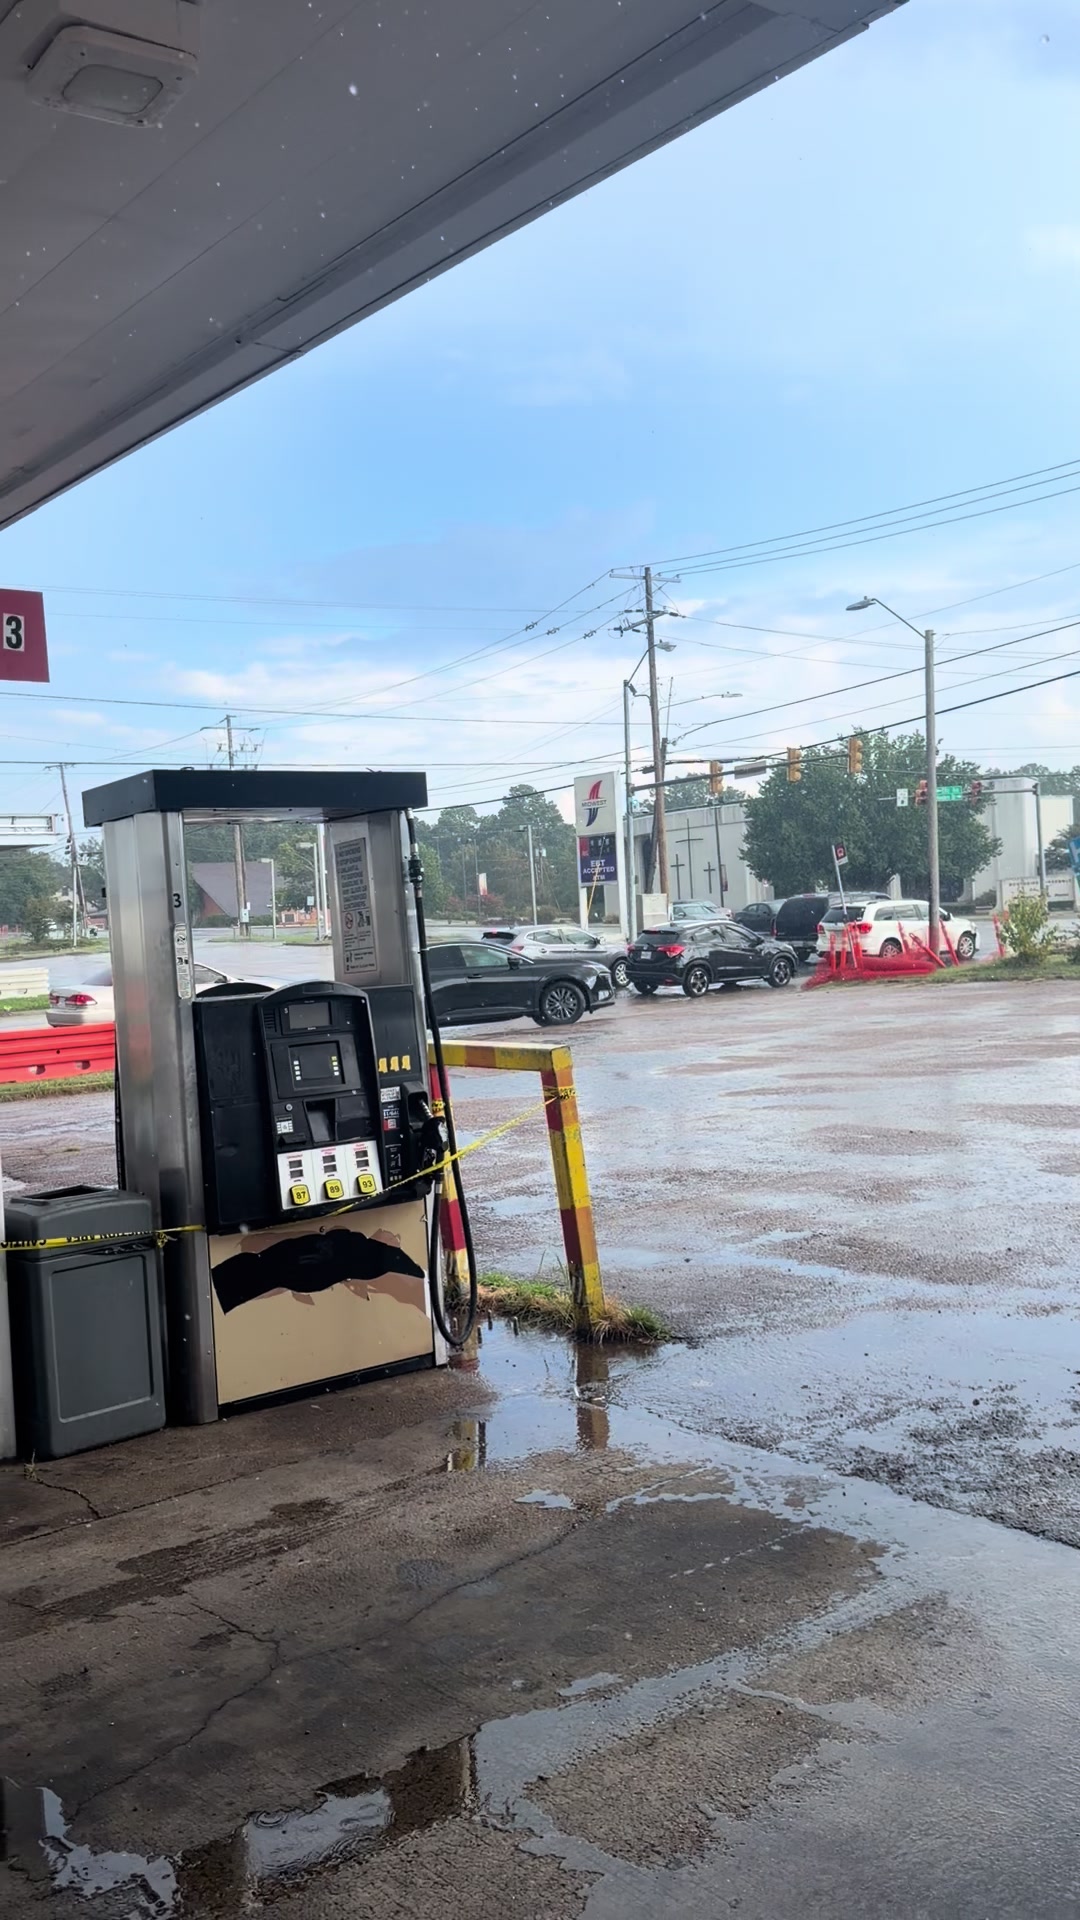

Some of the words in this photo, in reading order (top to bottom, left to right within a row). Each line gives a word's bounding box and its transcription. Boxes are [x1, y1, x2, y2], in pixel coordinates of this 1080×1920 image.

[6, 615, 22, 649] 3
[581, 799, 607, 808] MIDWEST
[172, 892, 182, 908] 3
[362, 1180, 373, 1188] 93
[329, 1185, 340, 1194] 89
[295, 1191, 306, 1200] 87
